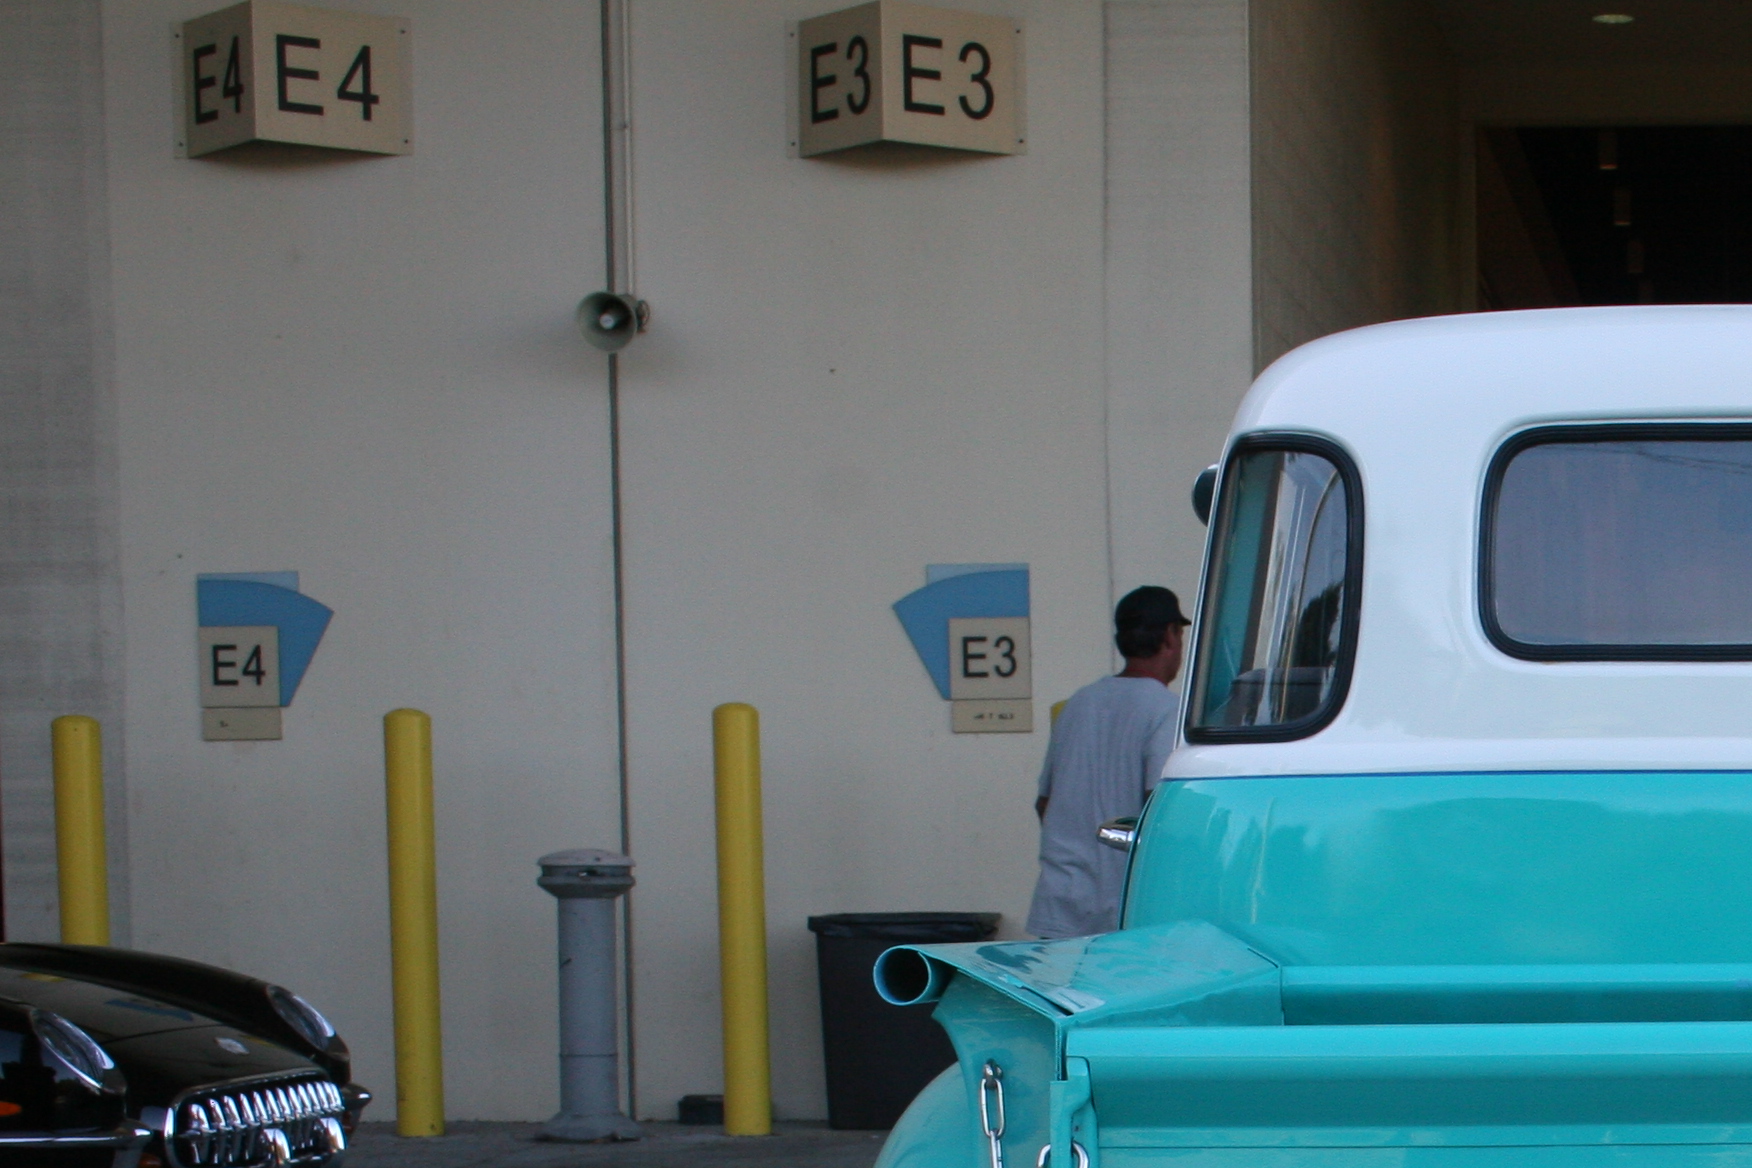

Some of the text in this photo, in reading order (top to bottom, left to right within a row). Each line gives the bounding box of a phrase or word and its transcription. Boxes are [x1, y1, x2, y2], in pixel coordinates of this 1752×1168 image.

[193, 35, 244, 125] E4
[276, 34, 380, 121] E4
[811, 35, 870, 124] E3
[903, 33, 994, 120] E3
[212, 644, 266, 686] E4
[962, 636, 1017, 678] E3
